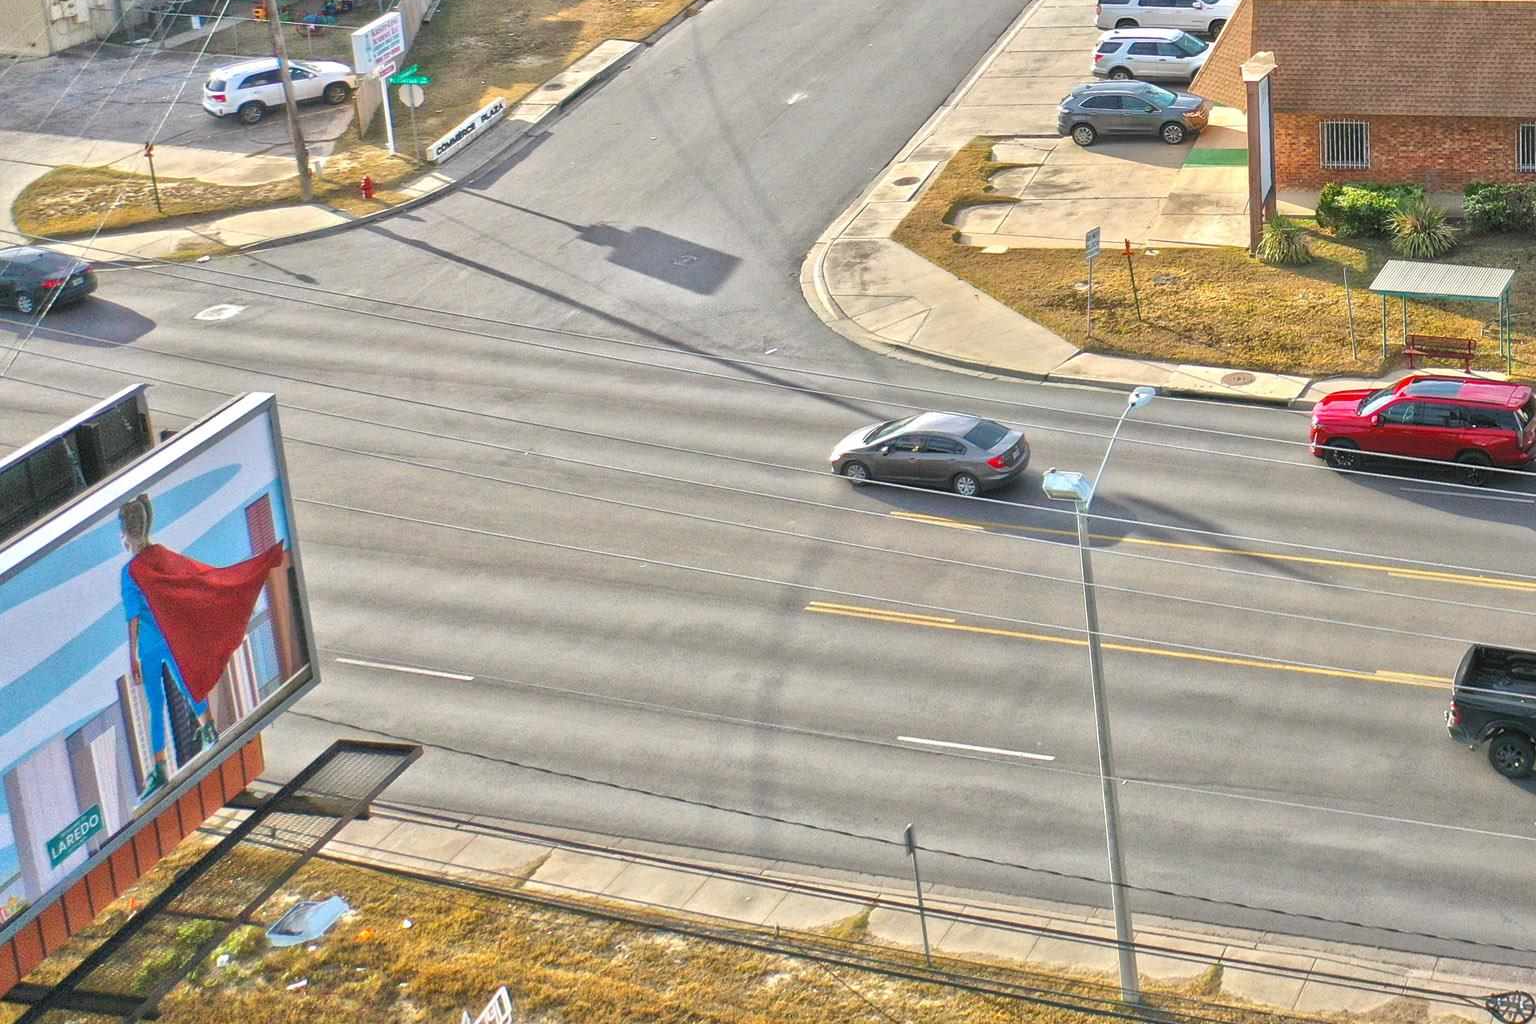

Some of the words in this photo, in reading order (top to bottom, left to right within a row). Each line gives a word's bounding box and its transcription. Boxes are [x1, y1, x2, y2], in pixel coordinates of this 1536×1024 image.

[436, 122, 475, 156] COMMERCE
[480, 102, 504, 123] PLAZA
[51, 814, 99, 859] LAREDO
